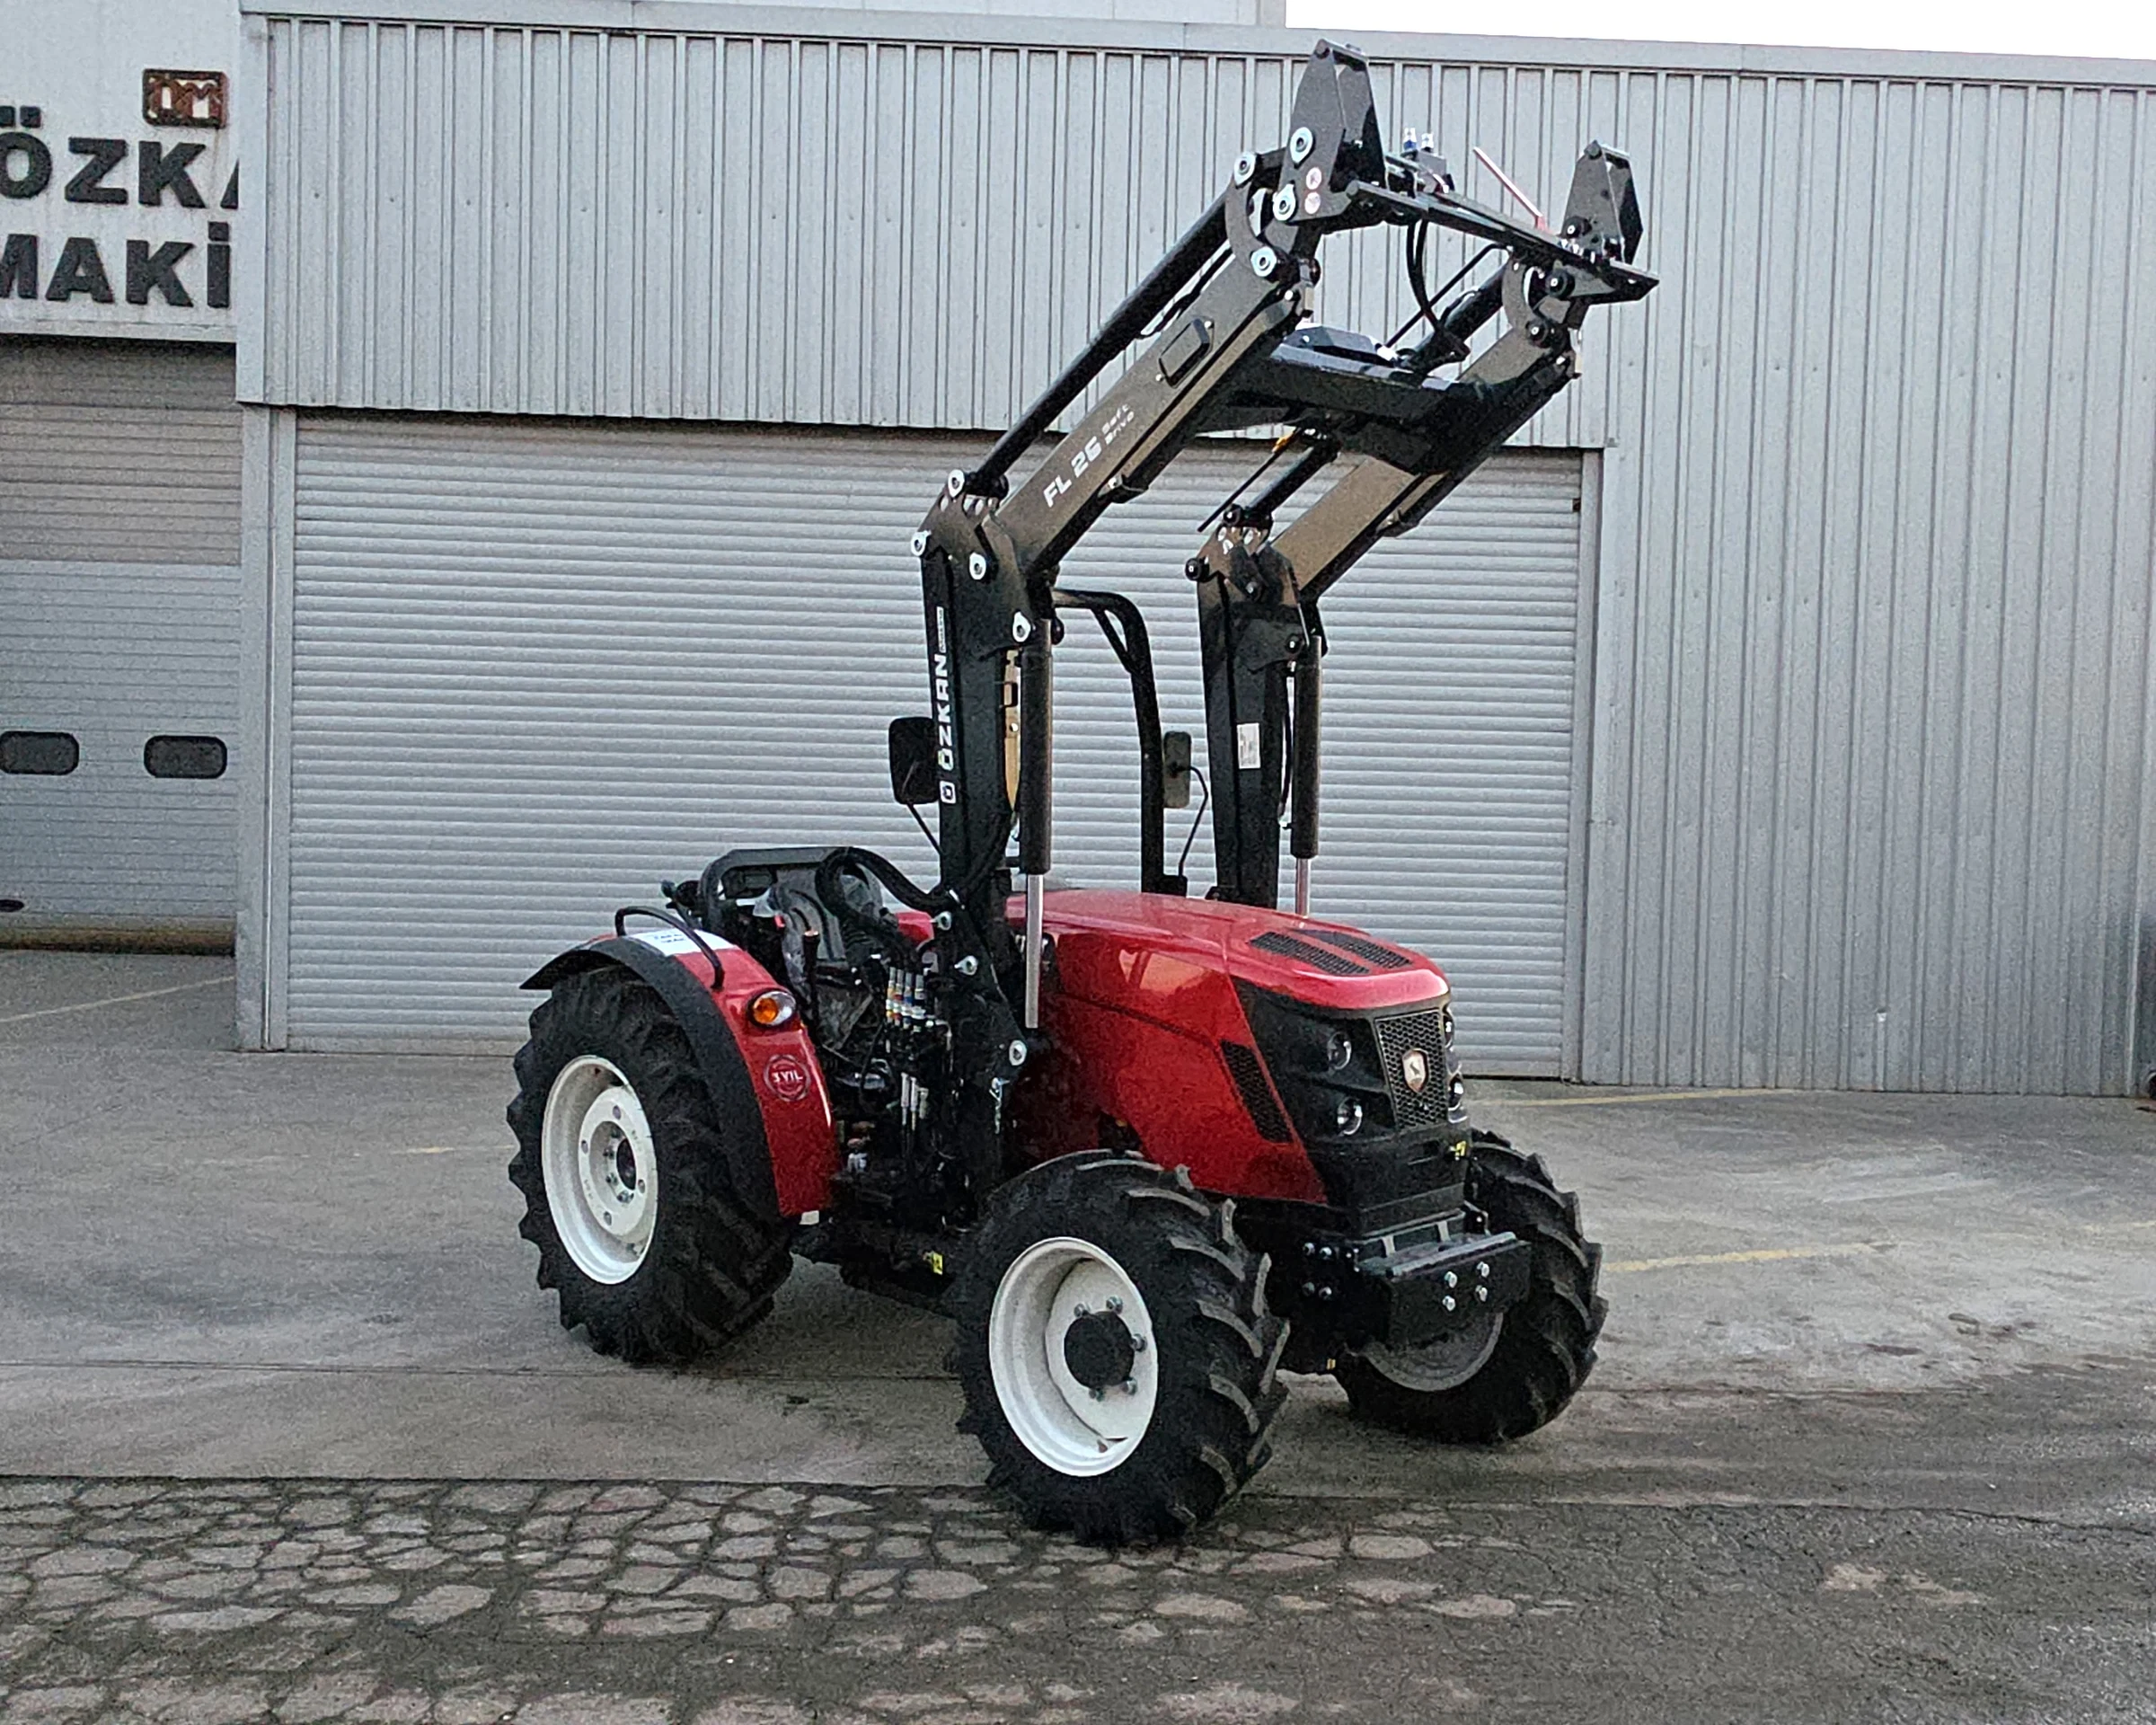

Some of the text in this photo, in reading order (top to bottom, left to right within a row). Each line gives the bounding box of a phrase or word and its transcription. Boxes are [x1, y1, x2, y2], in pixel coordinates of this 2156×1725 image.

[0, 104, 239, 209] ÖZK
[1043, 436, 1102, 508] FL 26
